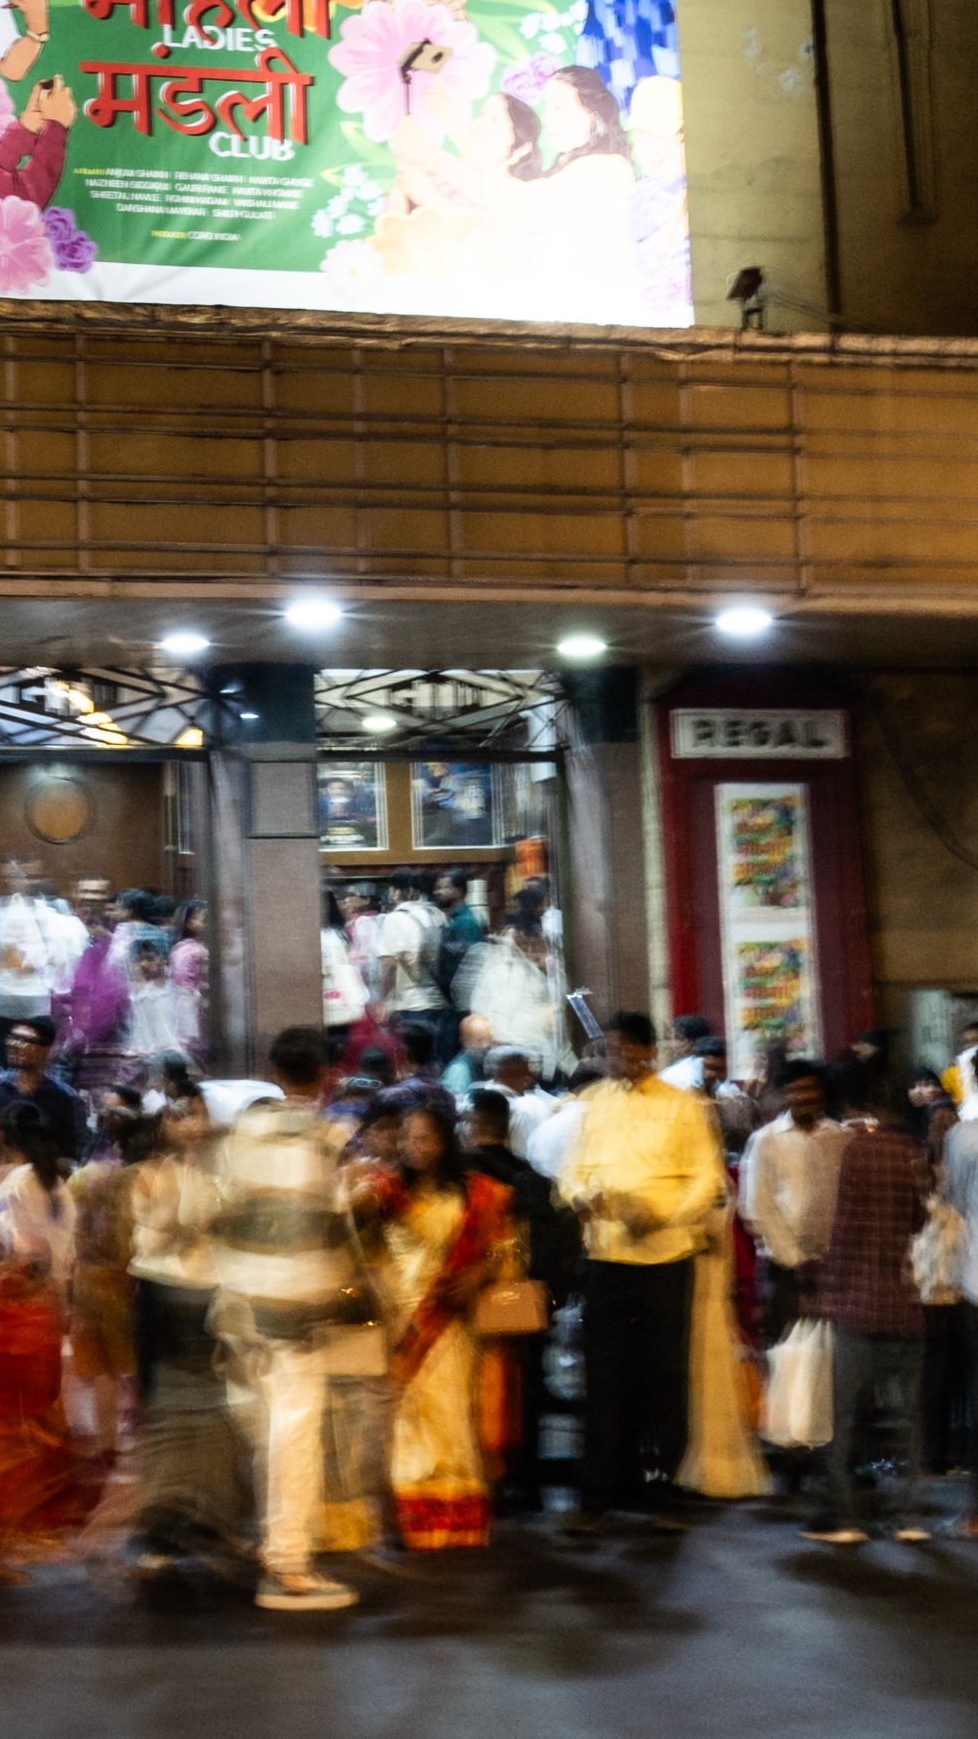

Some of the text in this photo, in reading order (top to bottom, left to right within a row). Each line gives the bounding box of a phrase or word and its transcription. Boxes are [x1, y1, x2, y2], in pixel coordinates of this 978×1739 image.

[162, 23, 278, 52] LADIES
[79, 42, 314, 145] मंडली
[208, 130, 296, 161] CLUB
[692, 719, 830, 748] REGAL
